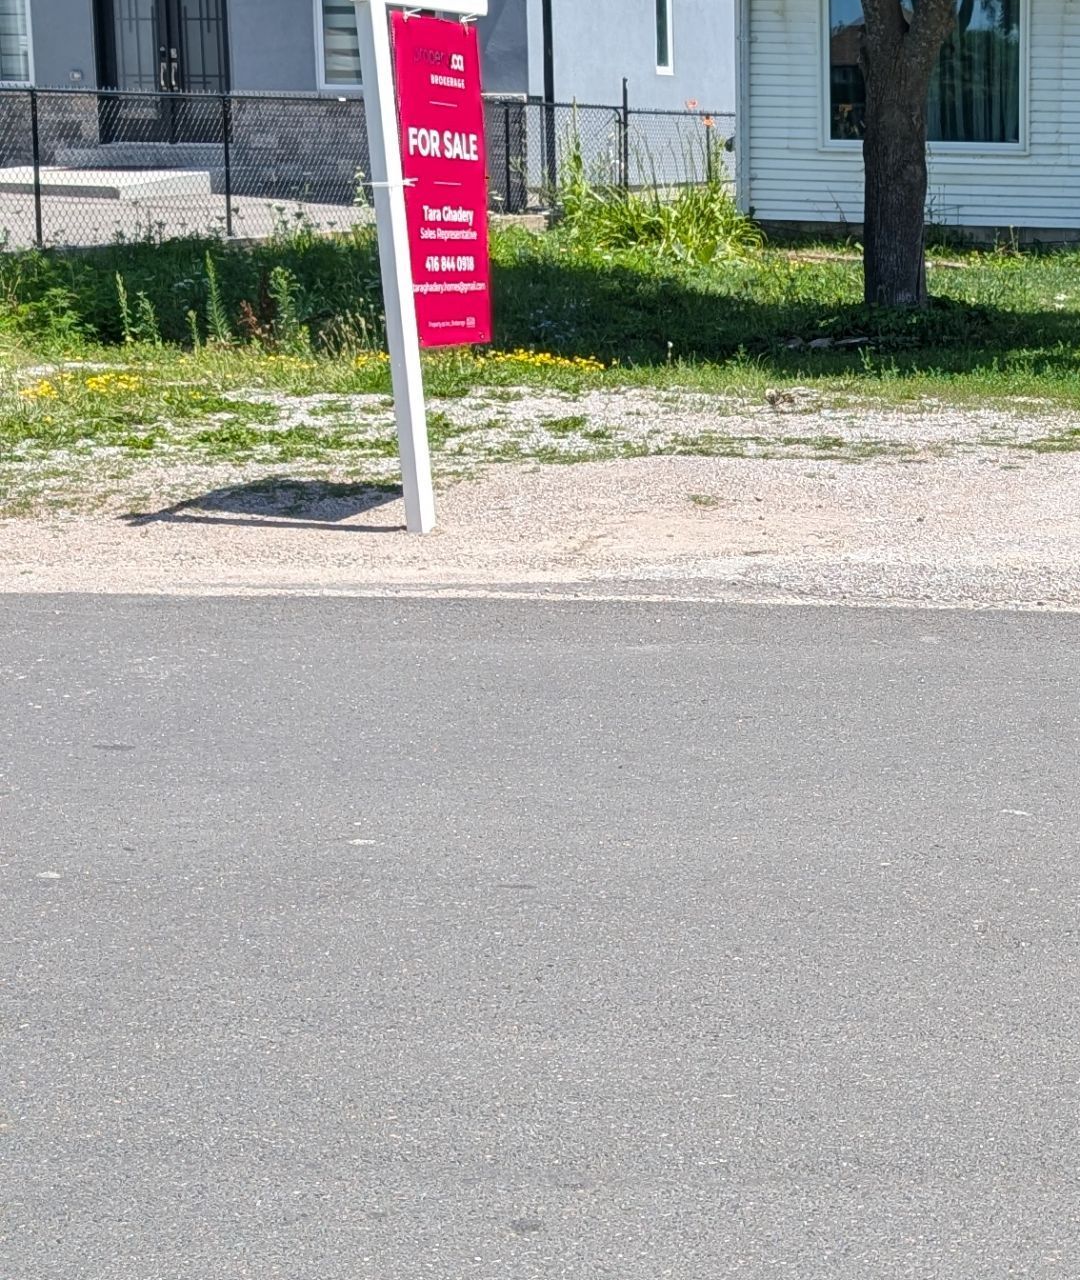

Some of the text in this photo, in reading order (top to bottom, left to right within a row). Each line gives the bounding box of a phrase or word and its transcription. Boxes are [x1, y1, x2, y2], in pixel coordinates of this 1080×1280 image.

[430, 73, 466, 90] BROKERAGE
[408, 126, 478, 161] FOR SALE
[422, 205, 474, 226] Tara Ghadery
[420, 227, 478, 242] Sales Representative
[425, 256, 475, 272] 416 844 0918
